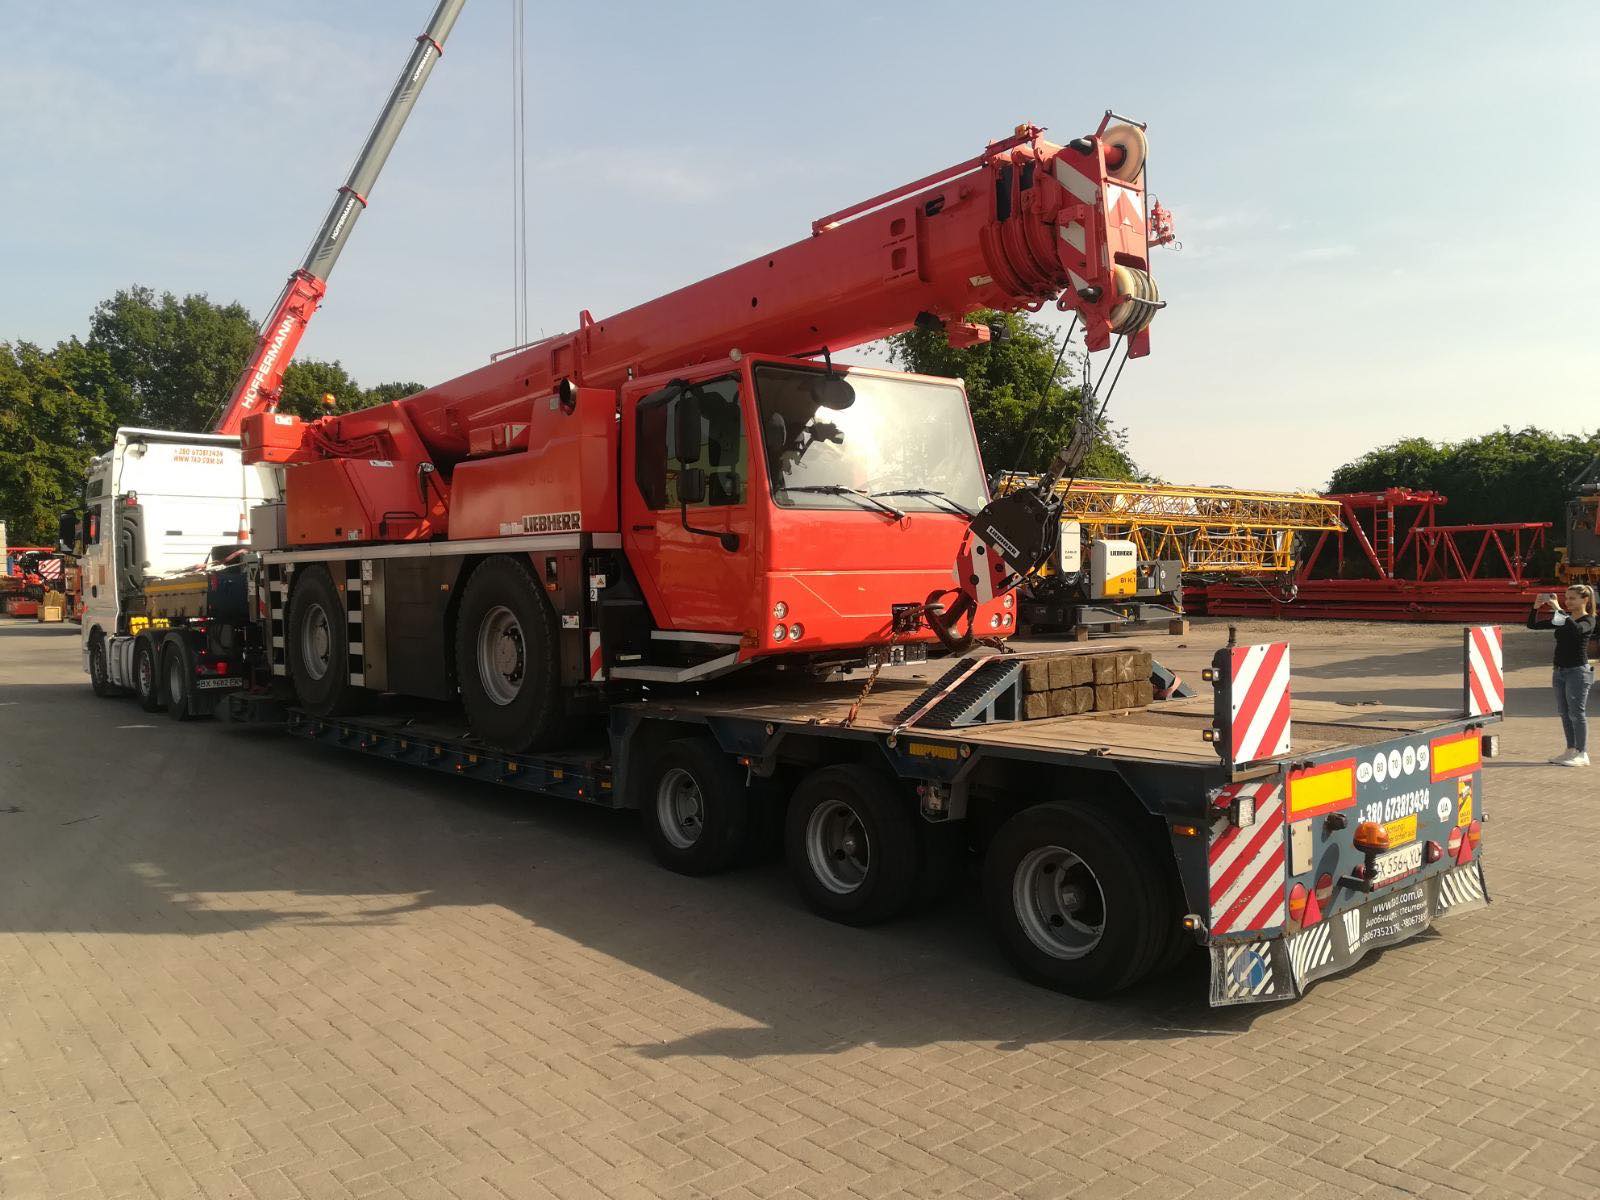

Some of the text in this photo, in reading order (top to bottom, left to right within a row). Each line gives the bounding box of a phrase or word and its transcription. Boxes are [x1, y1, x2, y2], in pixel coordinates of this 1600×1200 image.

[330, 197, 356, 240] HOFFERMANN
[241, 315, 296, 409] HOFFERMANN
[523, 512, 581, 533] LIEBHERR
[988, 526, 1018, 556] LIEBHERR
[1357, 787, 1430, 824] +380 673813434
